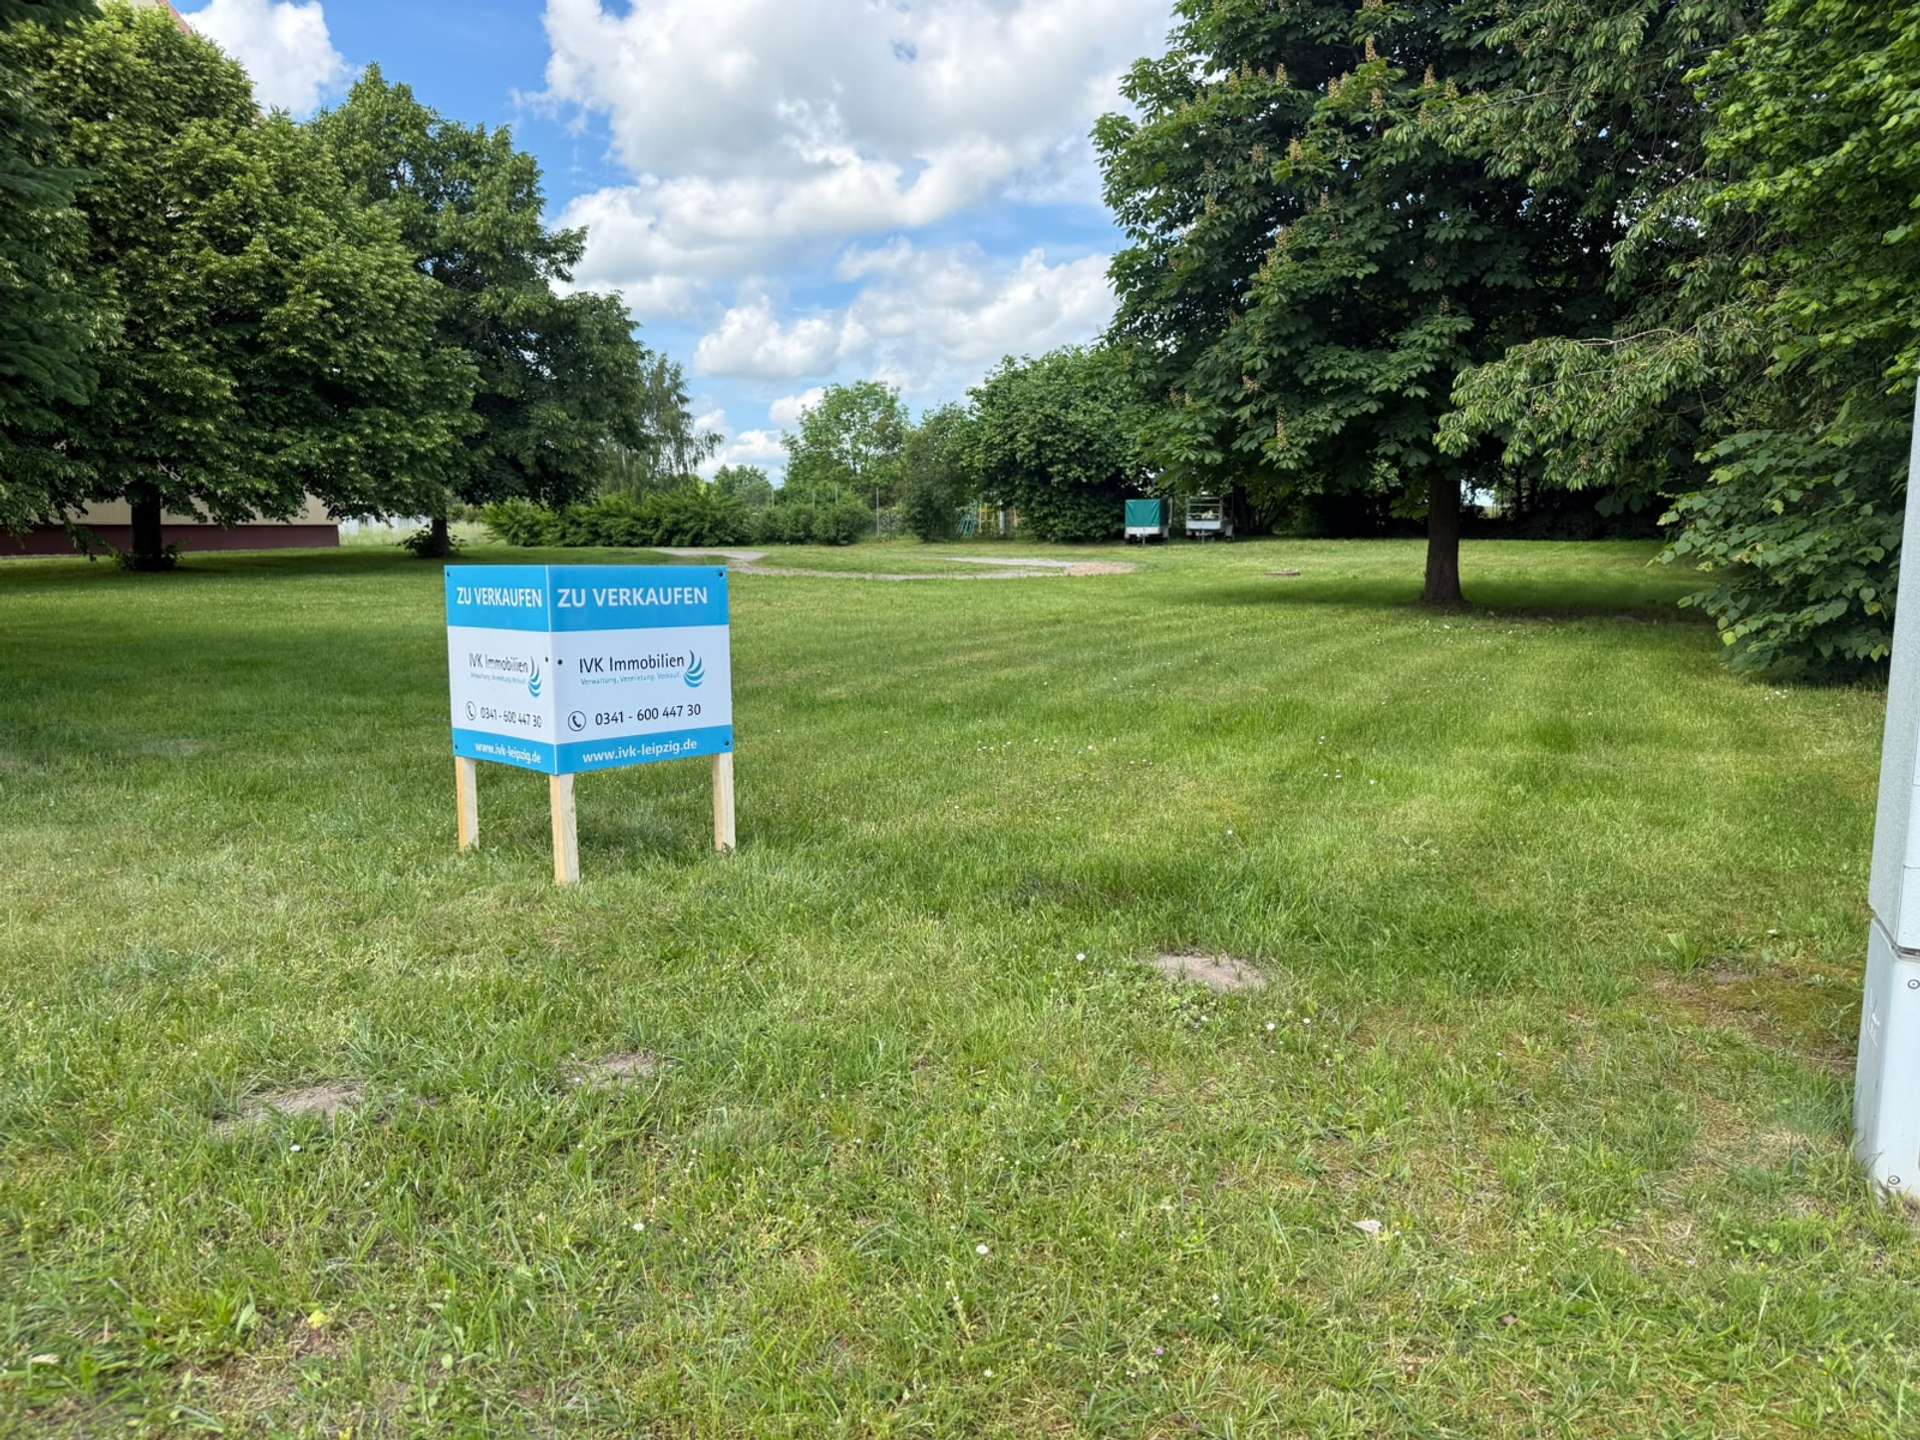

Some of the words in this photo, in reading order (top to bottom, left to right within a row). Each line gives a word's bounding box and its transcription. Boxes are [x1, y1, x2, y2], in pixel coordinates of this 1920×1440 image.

[456, 586, 471, 605] ZU
[474, 587, 542, 608] VERKAUFEN
[557, 588, 586, 608] ZU
[592, 586, 708, 607] VERKAUFEN
[468, 653, 483, 668] IVK
[485, 654, 529, 673] Immobilien
[579, 656, 604, 673] IVK
[609, 652, 685, 671] Immobilien
[480, 706, 498, 721] 0341
[518, 713, 531, 726] 447
[595, 711, 624, 726] 0341
[637, 707, 659, 722] 600
[662, 705, 683, 718] 447
[687, 703, 701, 716] 30
[475, 743, 542, 764] www.ivk-leipzig.de
[582, 738, 697, 763] www.ivk-leipzig.de
